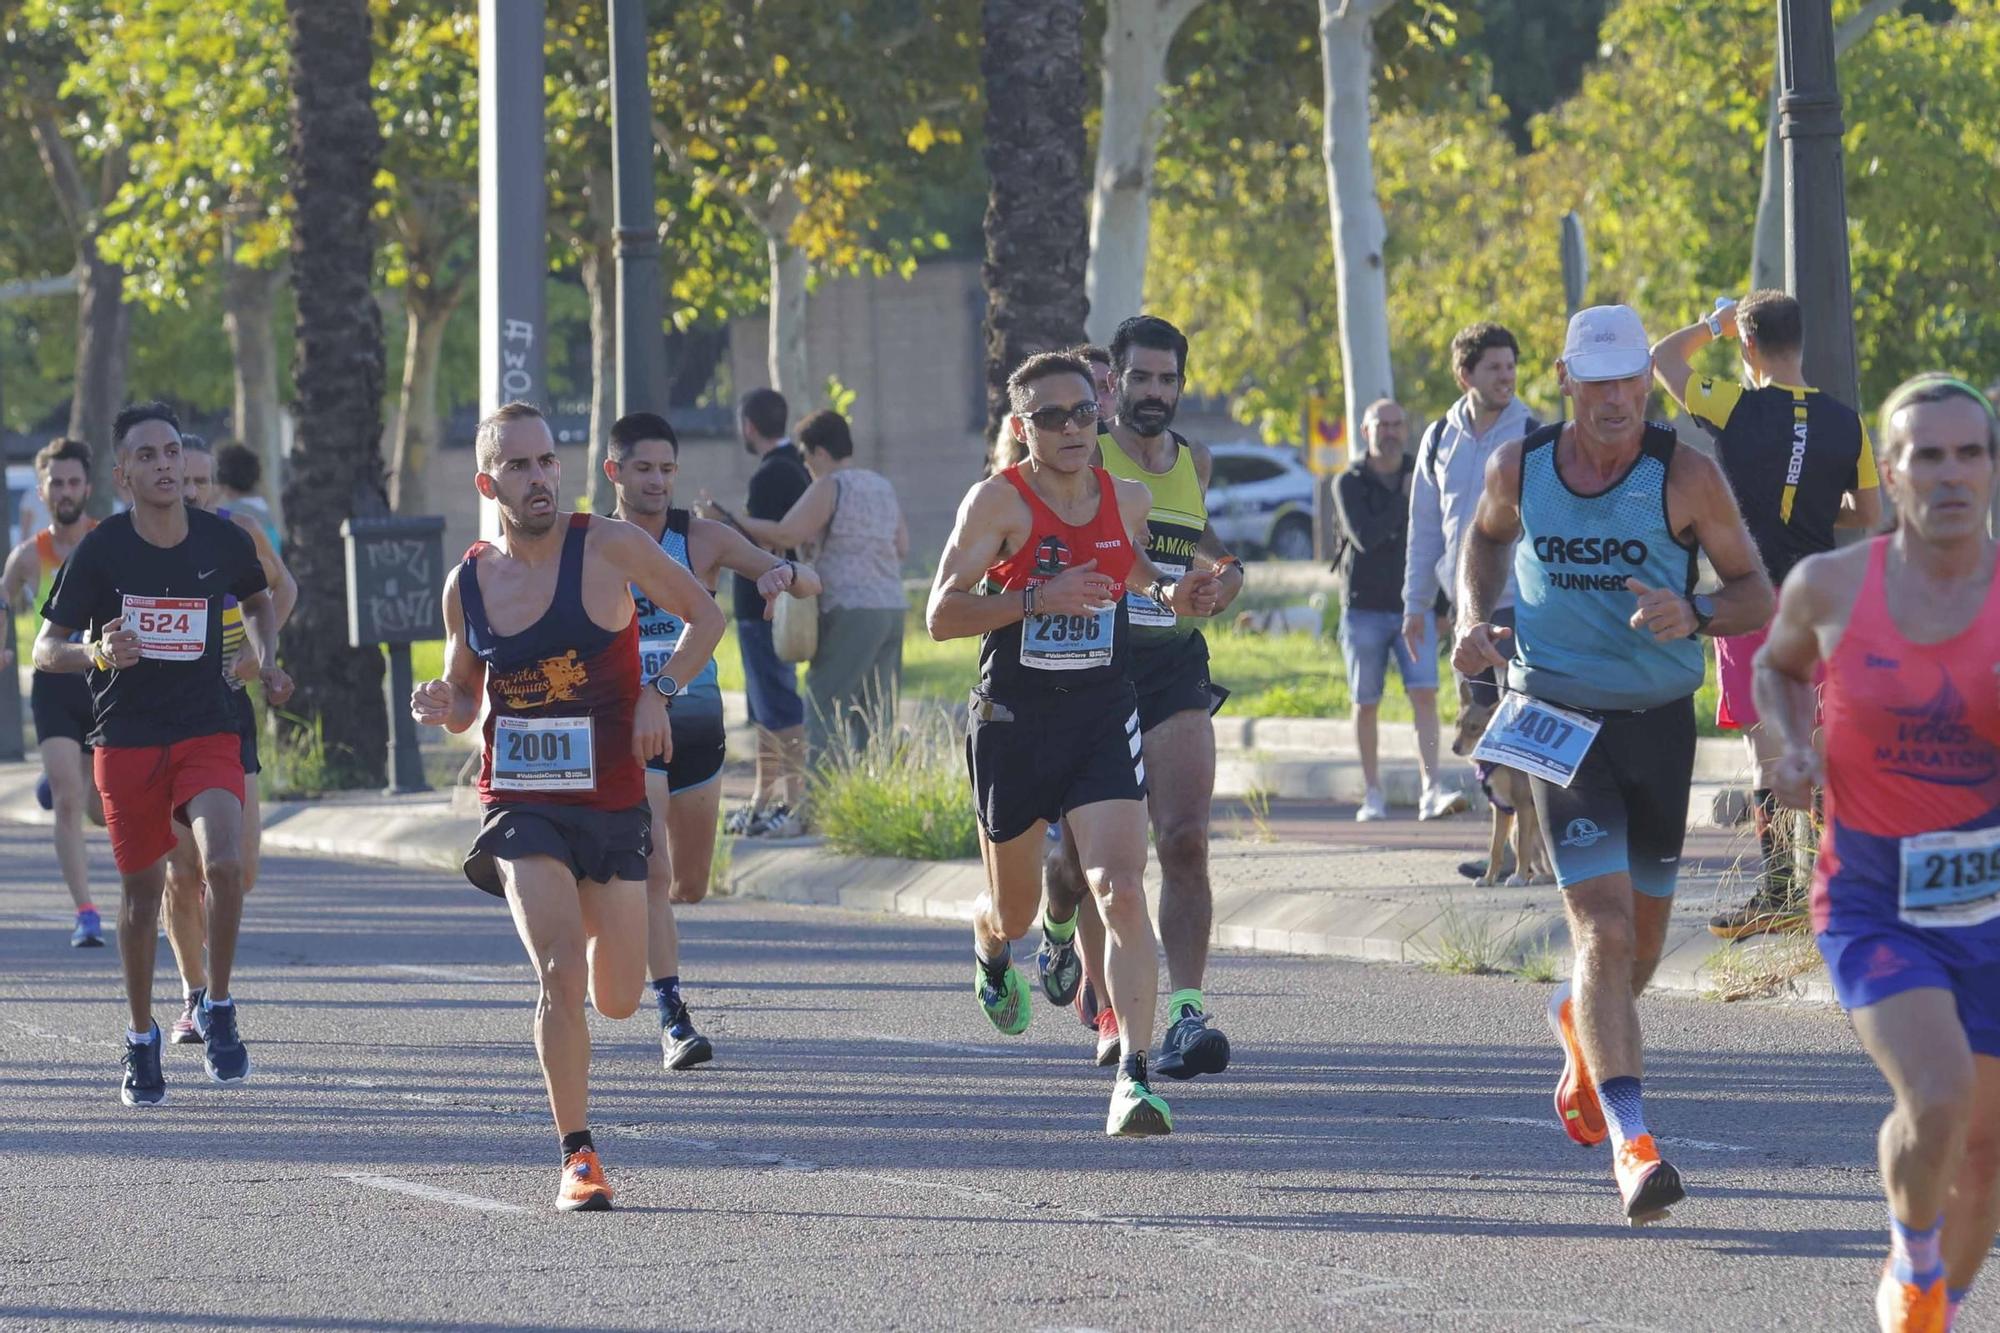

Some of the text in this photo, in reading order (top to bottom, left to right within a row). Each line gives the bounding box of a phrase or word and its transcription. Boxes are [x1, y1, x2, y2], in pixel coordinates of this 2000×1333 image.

[1095, 540, 1121, 549] FASTER
[1533, 536, 1648, 566] CRESPO
[139, 612, 190, 633] 524
[1034, 613, 1101, 641] 2396
[507, 732, 572, 761] 2001
